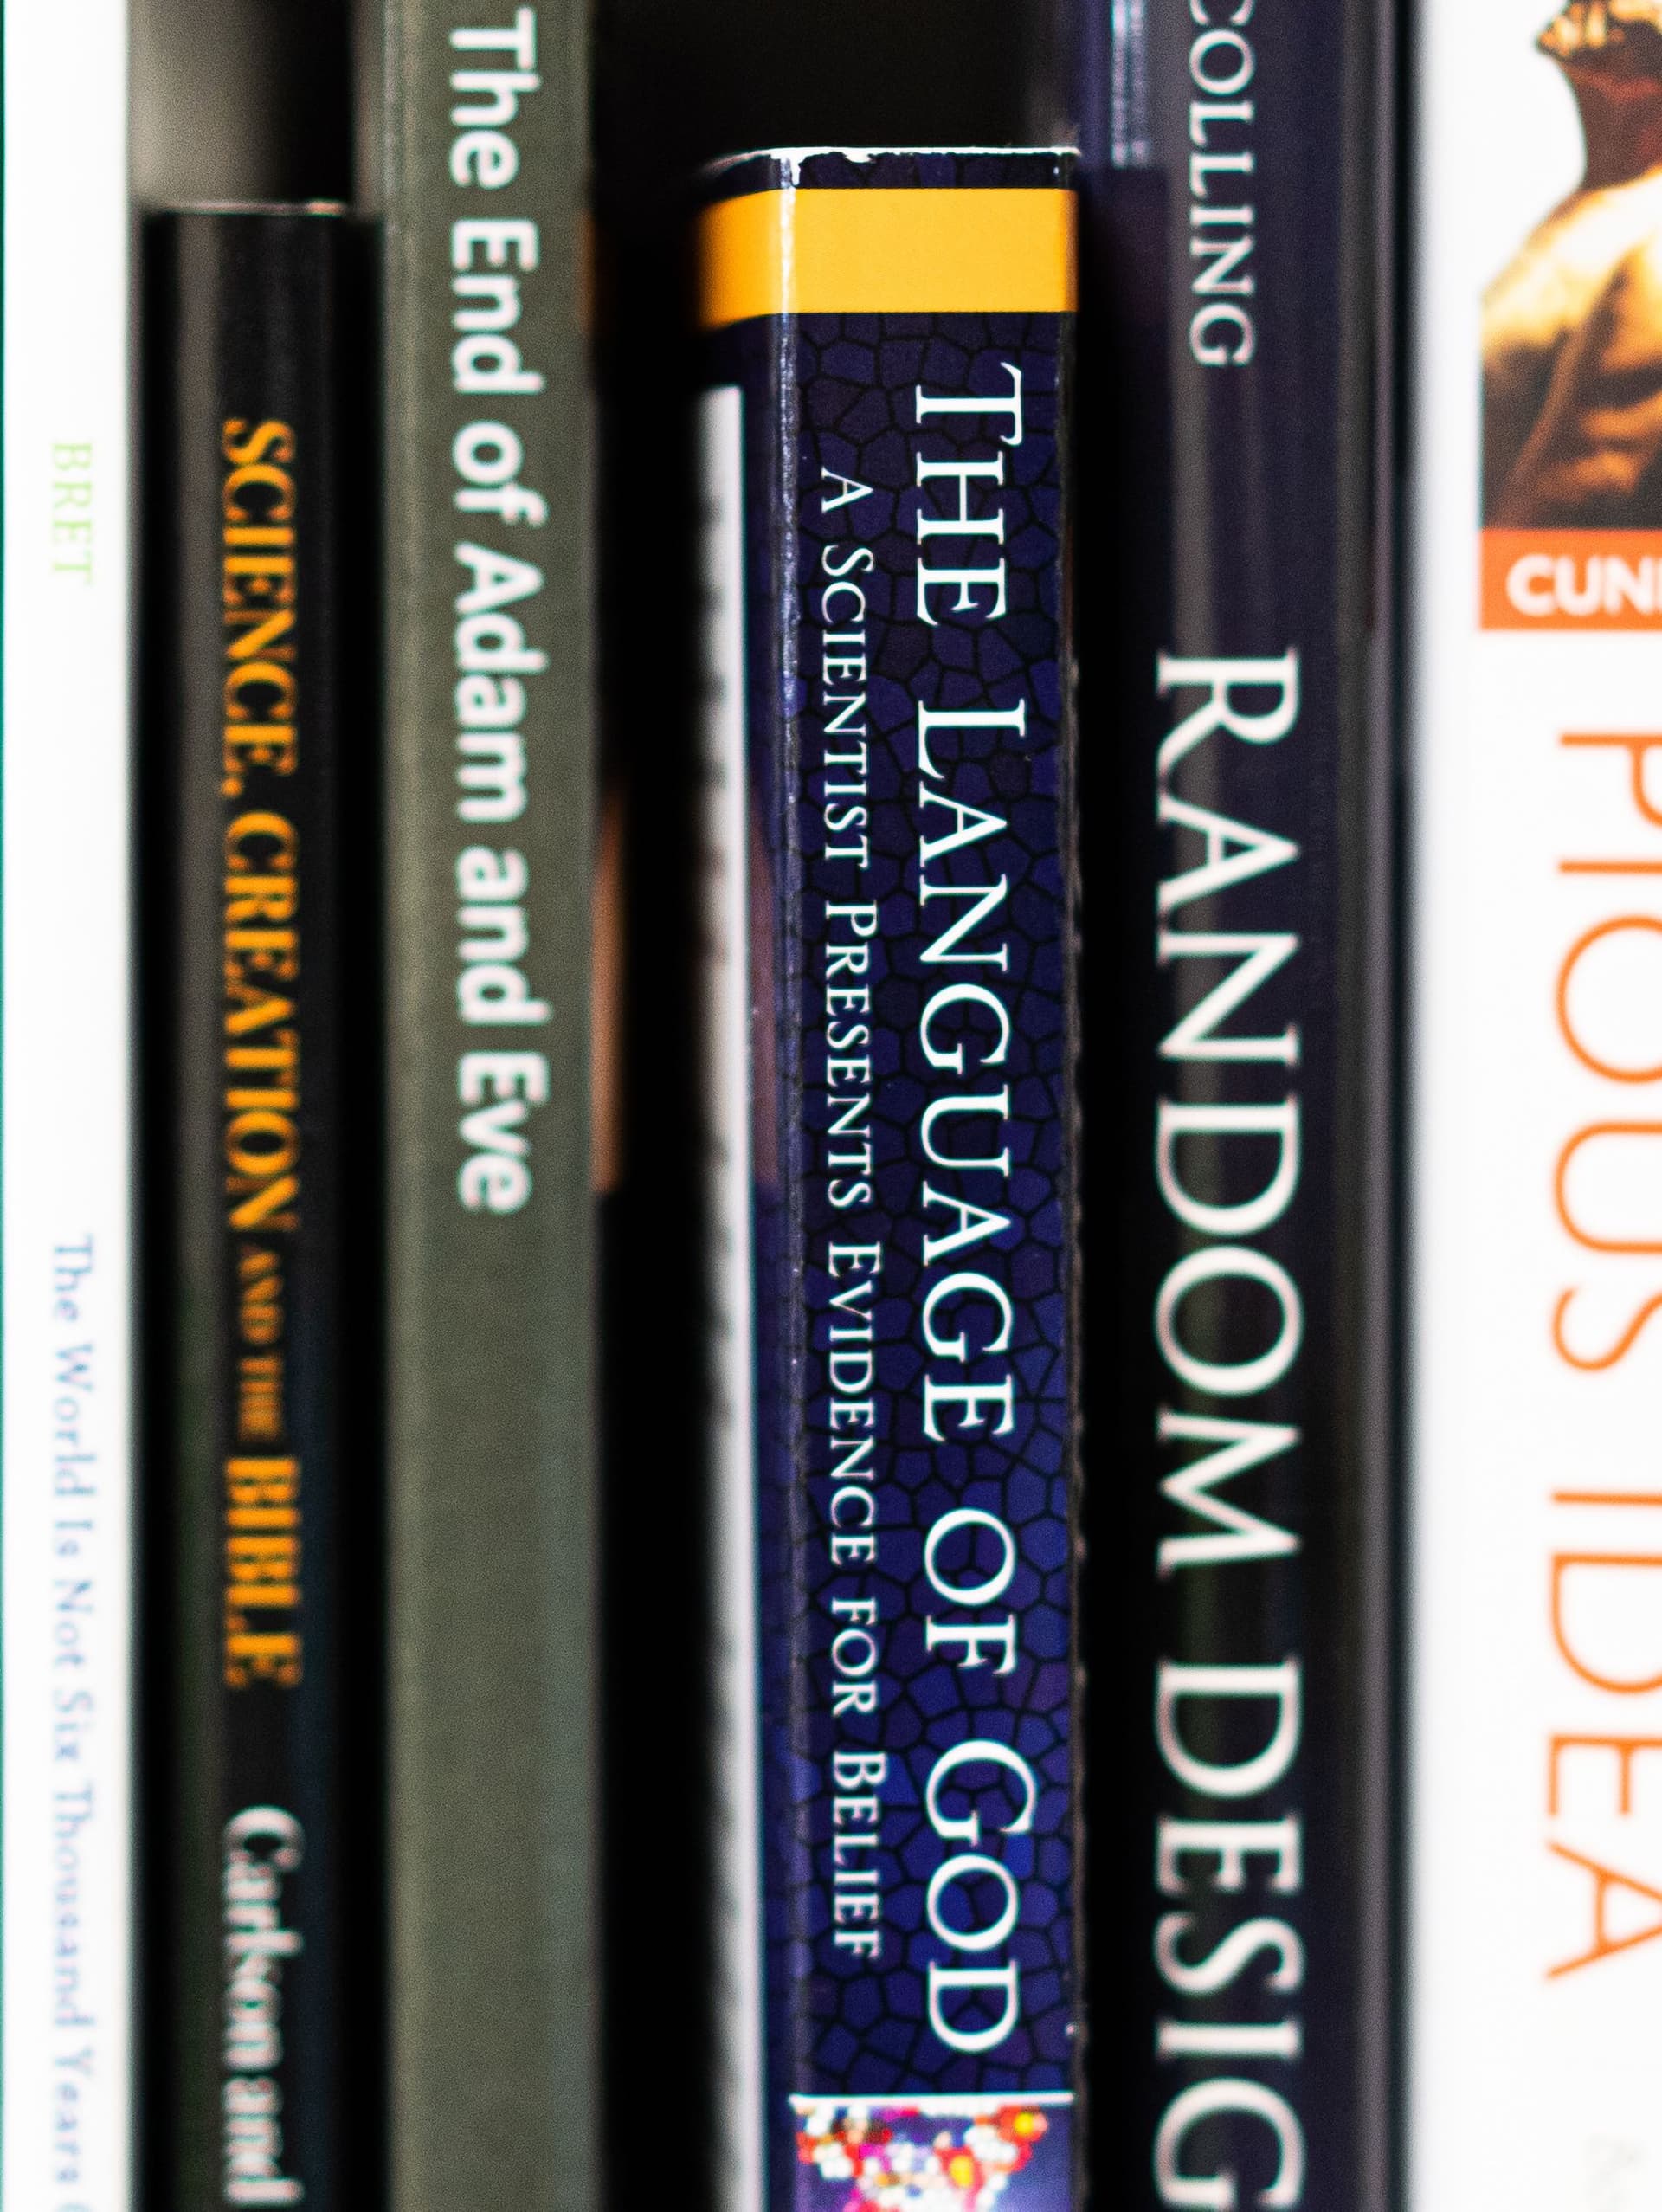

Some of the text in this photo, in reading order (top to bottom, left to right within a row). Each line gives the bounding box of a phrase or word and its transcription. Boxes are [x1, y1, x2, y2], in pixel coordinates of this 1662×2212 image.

[50, 440, 96, 587] BRET
[449, 6, 548, 1212] The End of Adam and Eve
[1506, 554, 1662, 616] CUN
[222, 810, 299, 1231] CREATION
[51, 1231, 97, 1325] The
[238, 1247, 280, 1345] AND
[820, 467, 887, 1958] A SCIENTIST PRESENTS EVIDENCE FOR BELIEF
[914, 360, 1036, 2054] THE LANGUAGE OF GOD
[52, 1340, 100, 1499] World
[1155, 648, 1304, 2212] RANDOM DESIG
[1543, 729, 1662, 1983] PIOUS IDEA
[51, 1517, 97, 1559] Is
[51, 1576, 98, 1670] Not
[224, 1456, 301, 1687] BIBLE
[51, 1688, 98, 1764] Six
[51, 1778, 99, 2030] Thousand
[222, 1804, 306, 2205] Carlson and
[51, 2044, 98, 2186] Years
